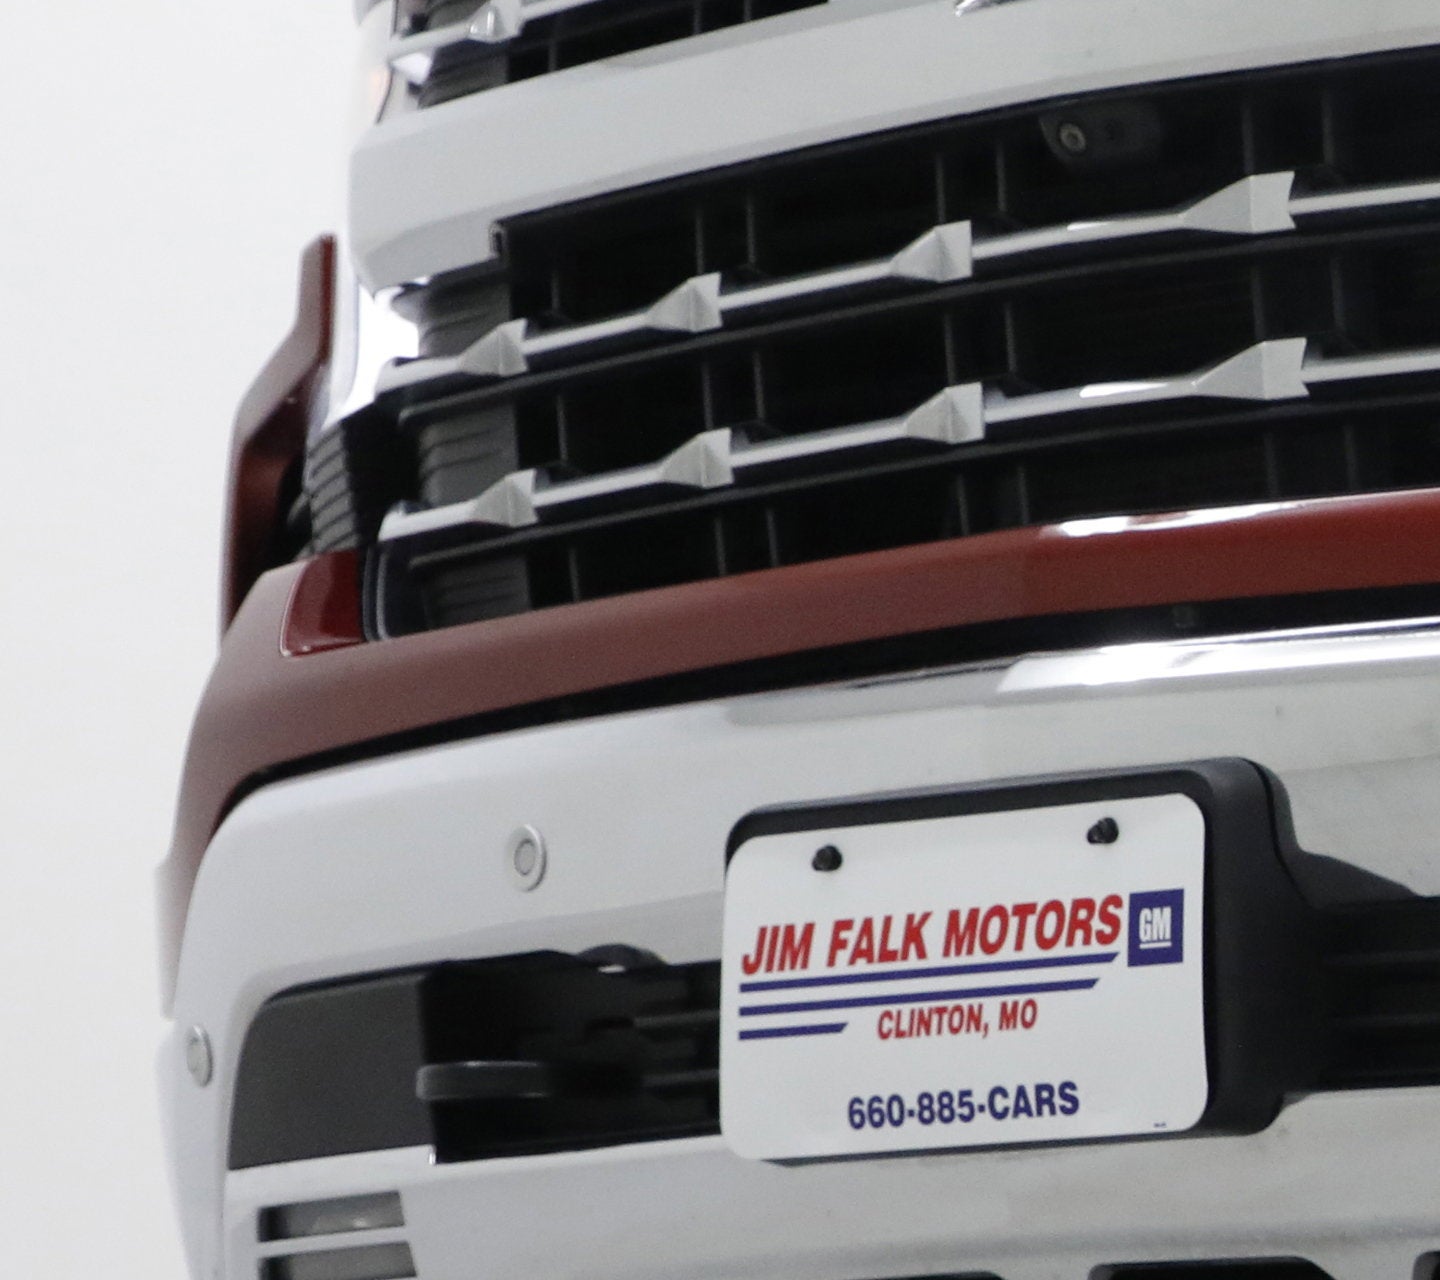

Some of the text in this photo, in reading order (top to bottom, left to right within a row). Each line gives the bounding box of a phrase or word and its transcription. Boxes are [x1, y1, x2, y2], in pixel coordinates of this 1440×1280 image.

[741, 894, 1124, 975] JIM FALK MOTORS
[1138, 906, 1172, 942] GM
[877, 999, 1038, 1040] CLINTON, MO
[848, 1081, 1080, 1130] 660-885-CARS
